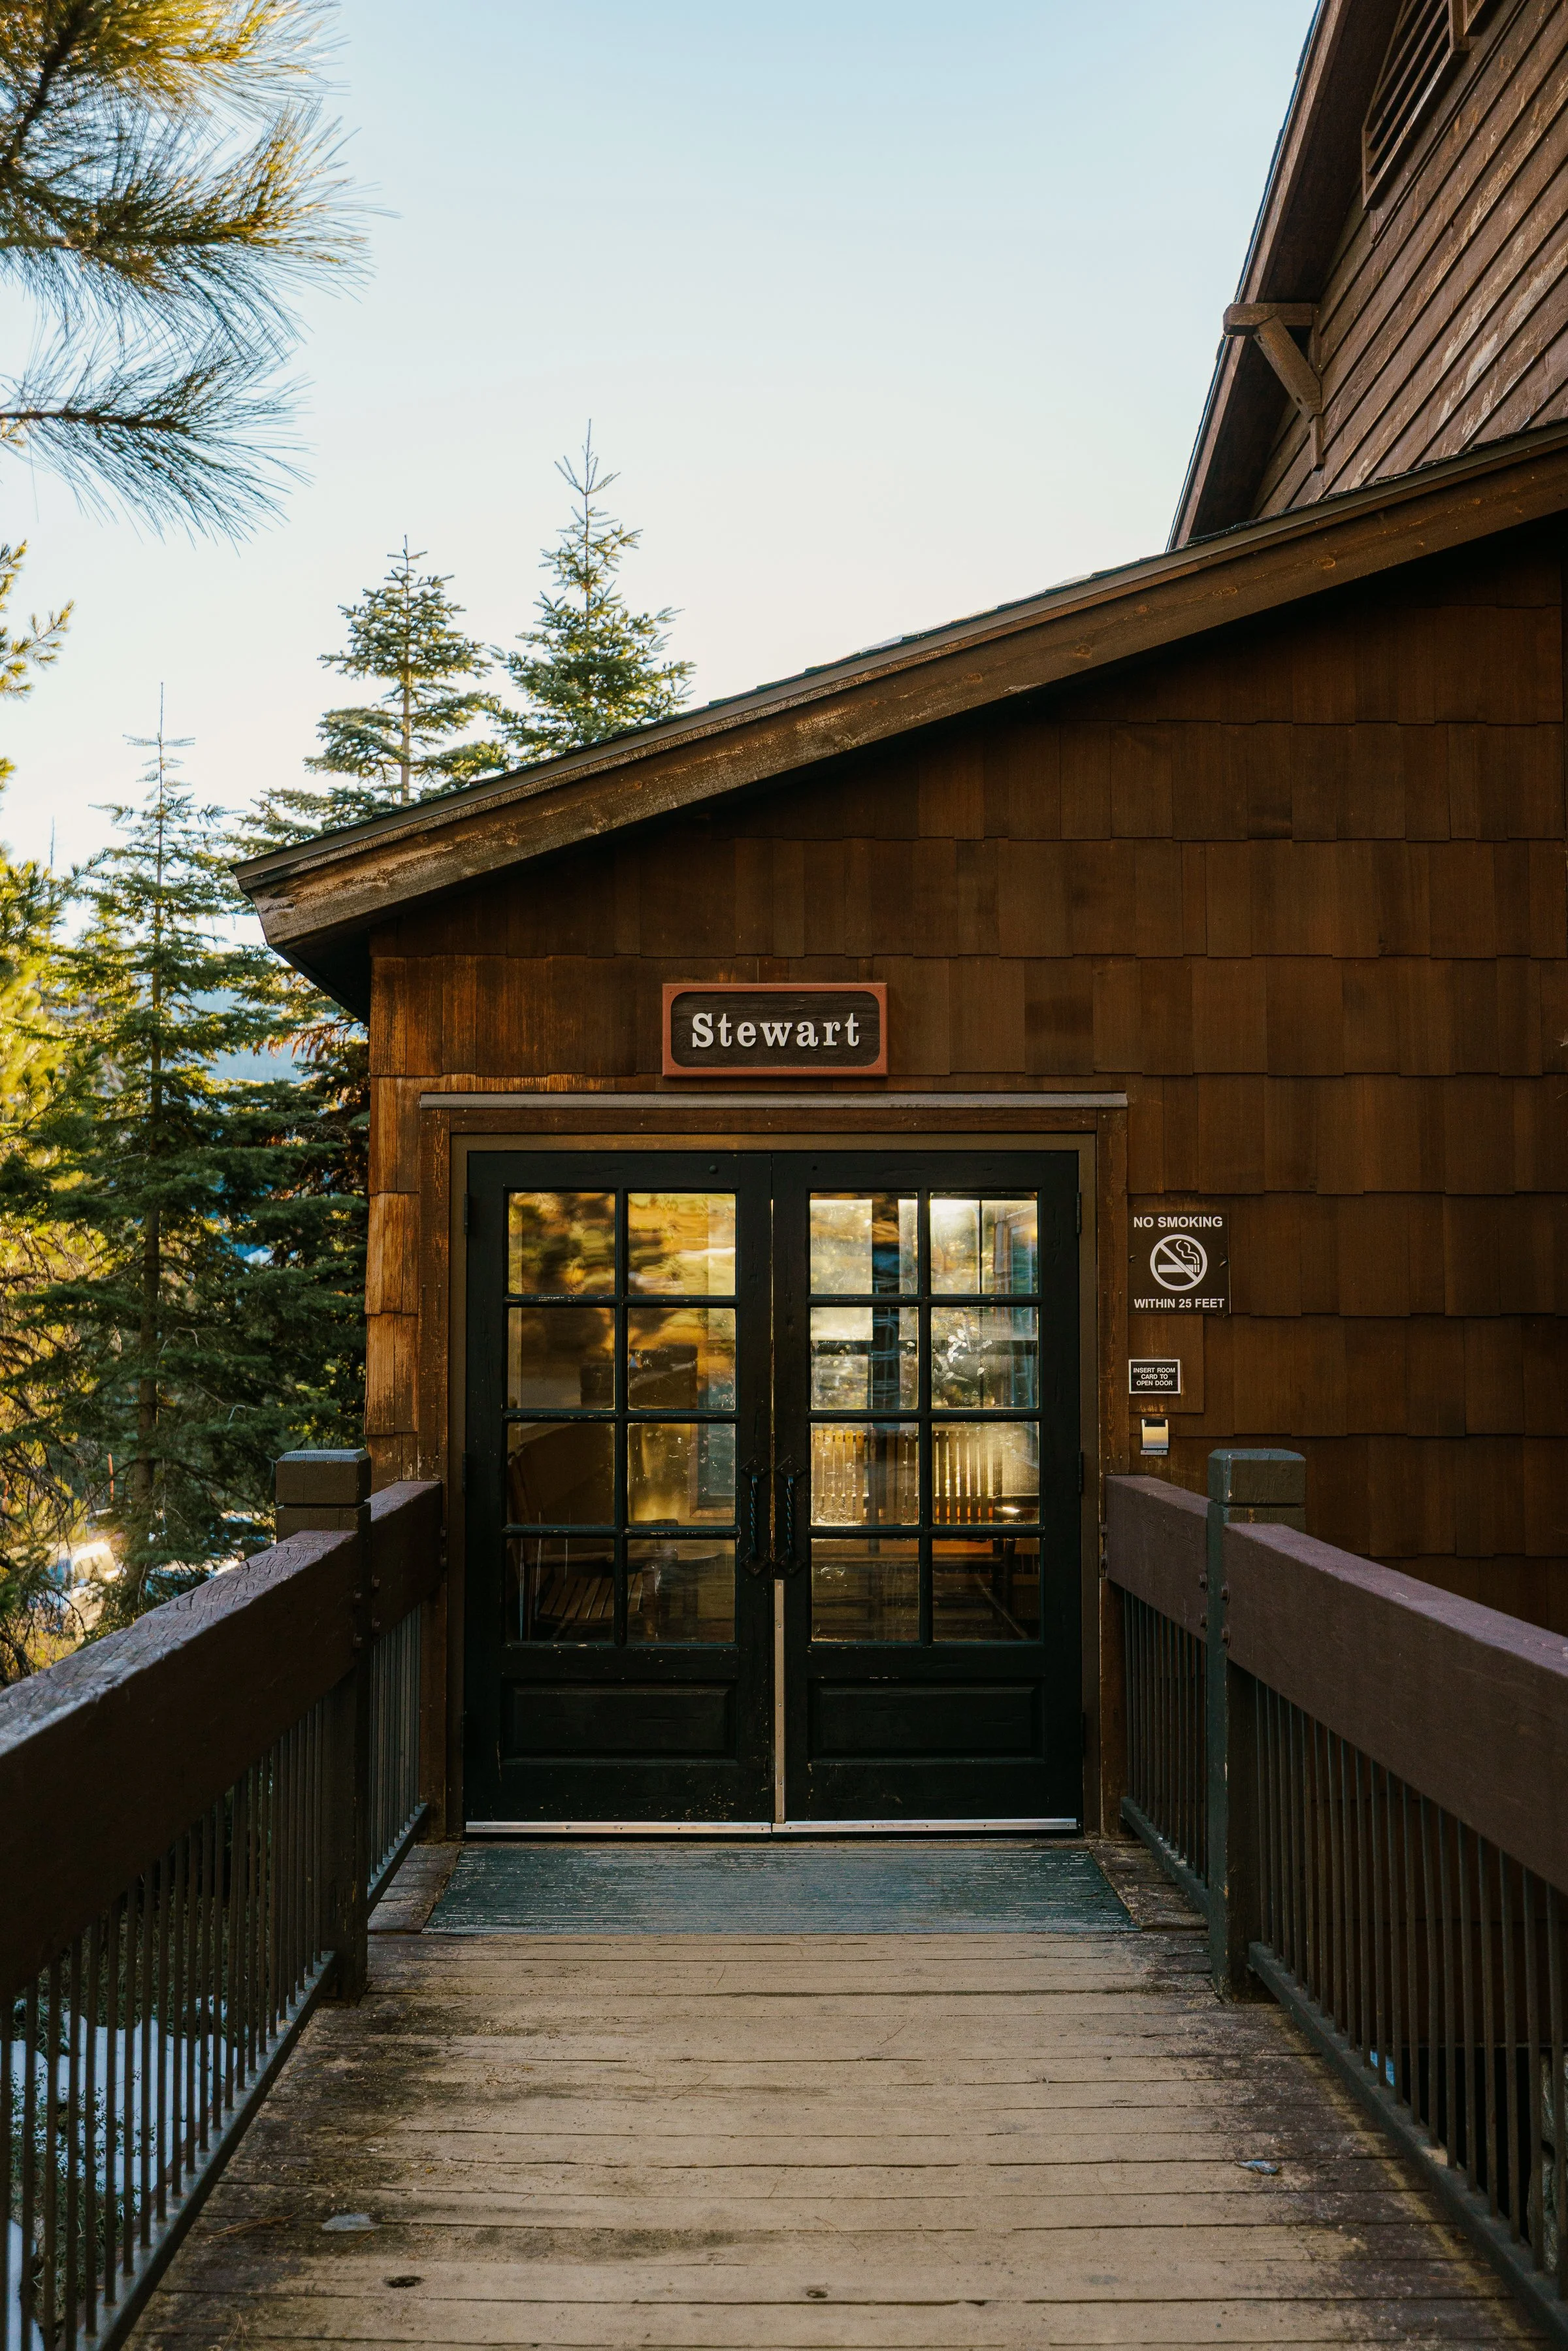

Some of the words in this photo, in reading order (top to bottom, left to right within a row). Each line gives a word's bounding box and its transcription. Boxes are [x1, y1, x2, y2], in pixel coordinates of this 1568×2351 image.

[692, 1012, 860, 1048] Stewart
[1134, 1216, 1154, 1228] NO
[1158, 1216, 1223, 1228] SMOKING
[1134, 1298, 1175, 1308] WITHIN
[1179, 1298, 1192, 1308] 25
[1195, 1298, 1225, 1308] FEET
